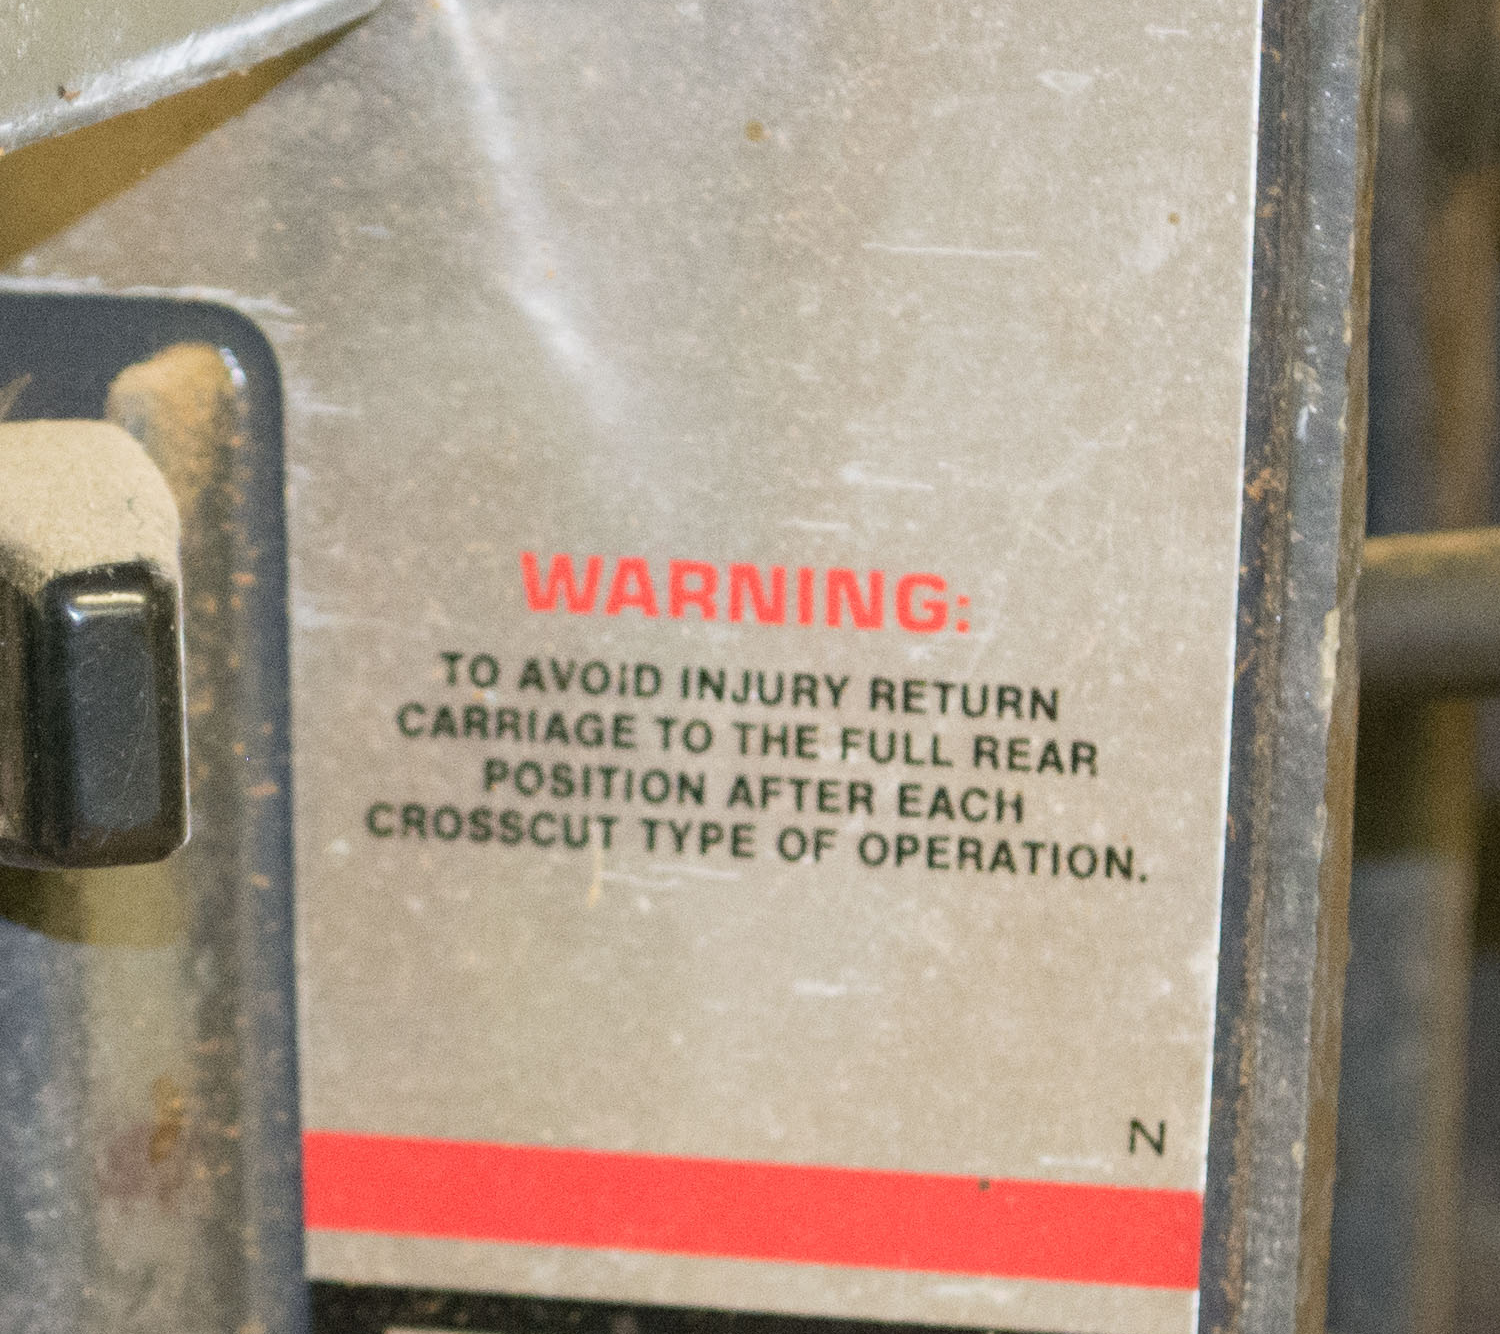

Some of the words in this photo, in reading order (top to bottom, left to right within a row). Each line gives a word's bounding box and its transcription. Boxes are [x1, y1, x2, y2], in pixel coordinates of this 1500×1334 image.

[518, 551, 972, 635] WARNING:
[439, 651, 500, 692] TO
[517, 657, 664, 700] AVOID
[680, 666, 851, 712] INJURY
[868, 675, 1061, 723] RETURN
[396, 701, 638, 752] CARRIAGE
[654, 715, 715, 757] TO
[731, 721, 821, 763] THE
[840, 726, 954, 770] FULL
[971, 734, 1101, 779] REAR
[482, 757, 707, 809] POSITION
[725, 773, 877, 819] AFTER
[896, 782, 1026, 826] EACH
[364, 800, 618, 852] CROSSCUT
[640, 816, 757, 861] TYPE
[776, 826, 840, 866] OF
[857, 832, 1151, 886] OPERATION.
[1128, 1117, 1167, 1157] N
